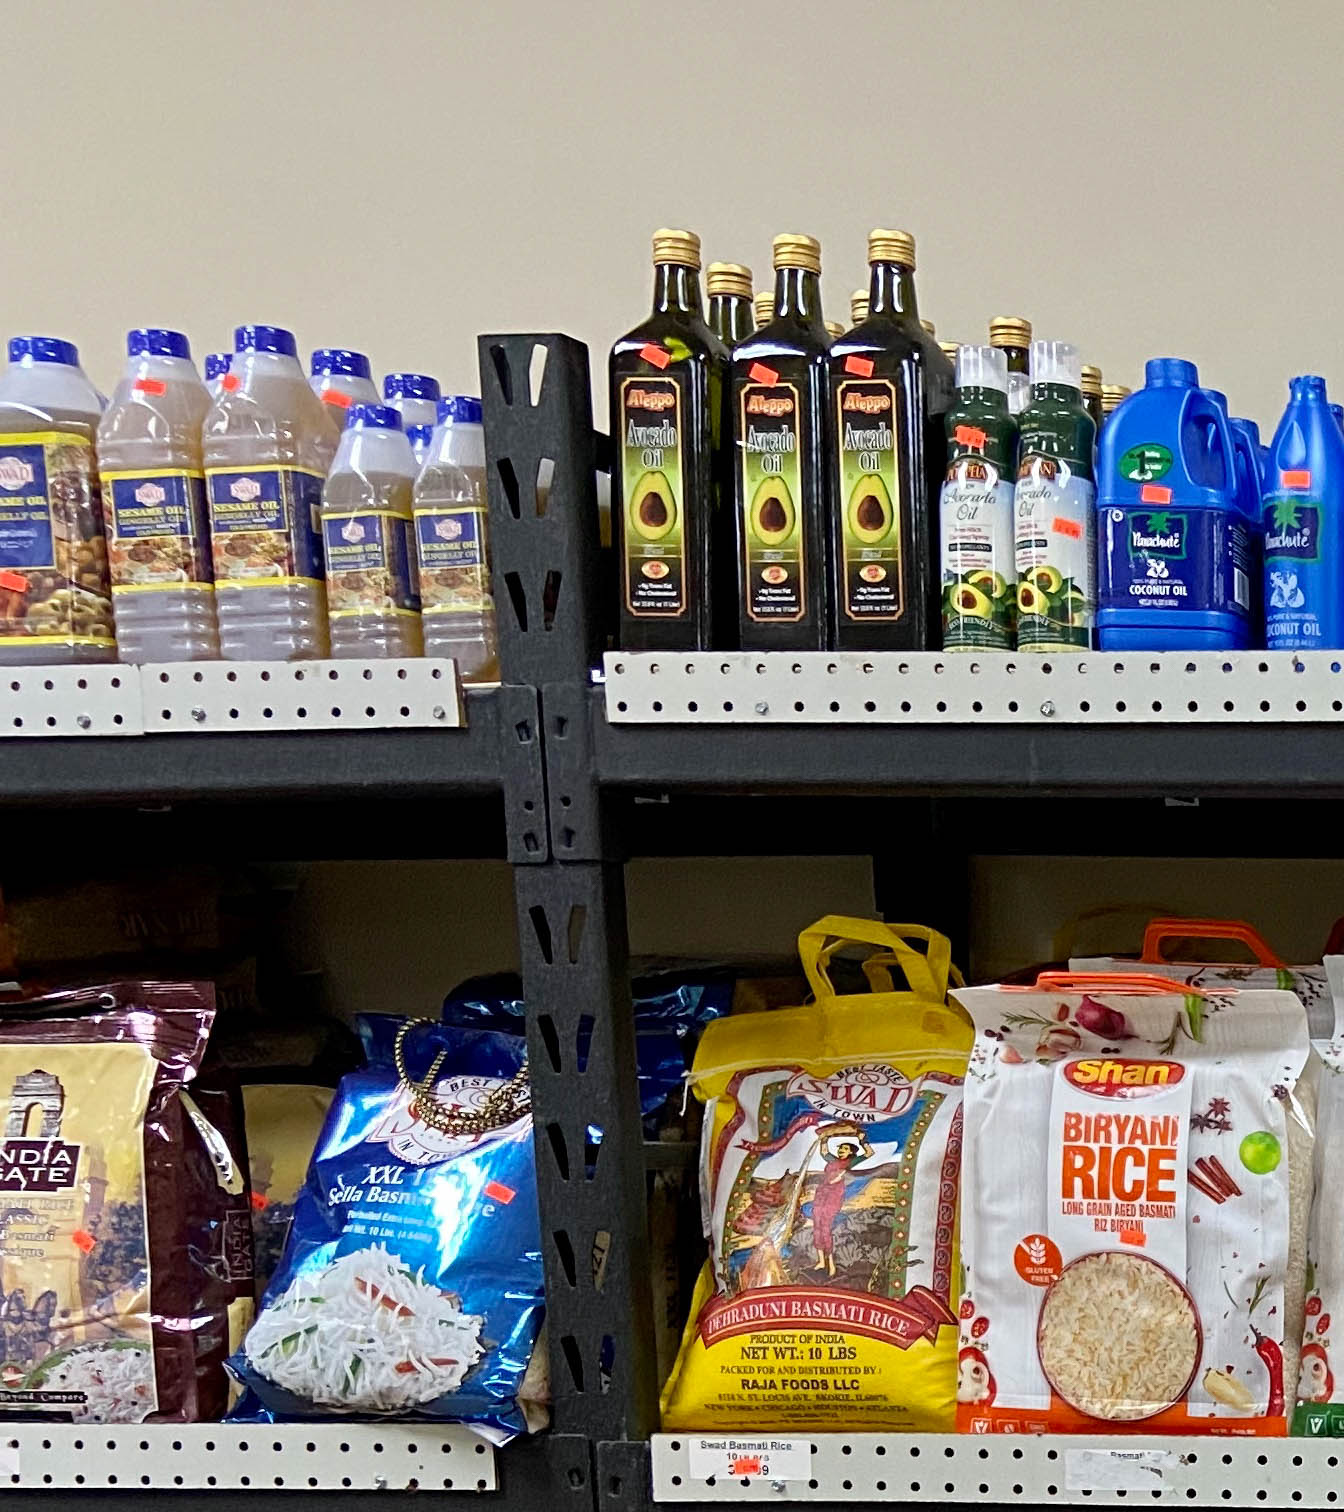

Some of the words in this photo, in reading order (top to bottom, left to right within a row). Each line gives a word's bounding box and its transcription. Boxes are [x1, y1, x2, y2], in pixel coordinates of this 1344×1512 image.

[628, 390, 674, 411] Aleppo
[748, 396, 794, 415] Aleppo
[844, 392, 890, 412] Aleppo
[627, 420, 676, 448] Avocado
[748, 426, 795, 452] Avocado
[843, 422, 892, 451] Avocado
[641, 448, 663, 469] Oil
[761, 454, 783, 473] Oil
[859, 451, 880, 471] Oil
[1129, 584, 1170, 597] COCONUT
[1172, 585, 1188, 597] OIL
[1072, 1060, 1171, 1087] Shan
[1063, 1112, 1179, 1146] BIRYANI
[0, 1150, 72, 1164] NDIA
[362, 1166, 405, 1185] XXL
[1062, 1146, 1176, 1201] RICE
[329, 1186, 363, 1206] Sella
[1062, 1201, 1084, 1216] LONG
[1086, 1202, 1112, 1217] GRAIN
[1115, 1203, 1137, 1217] AGED
[1139, 1204, 1175, 1218] BASMATI
[707, 1302, 787, 1333] DEHRADUNI
[792, 1301, 867, 1322] BASMATI
[873, 1309, 910, 1337] RICE
[750, 1334, 790, 1344] PRODUCT
[794, 1335, 812, 1344] OF
[815, 1334, 845, 1345] INDIA
[741, 1348, 768, 1360] NET
[808, 1348, 823, 1360] 10
[828, 1347, 856, 1360] LBS
[741, 1379, 777, 1390] RAJA
[781, 1379, 829, 1390] FOODS
[833, 1379, 860, 1390] LLC
[700, 1441, 726, 1450] Swad
[729, 1441, 767, 1451] Basmati
[770, 1441, 792, 1451] Rice
